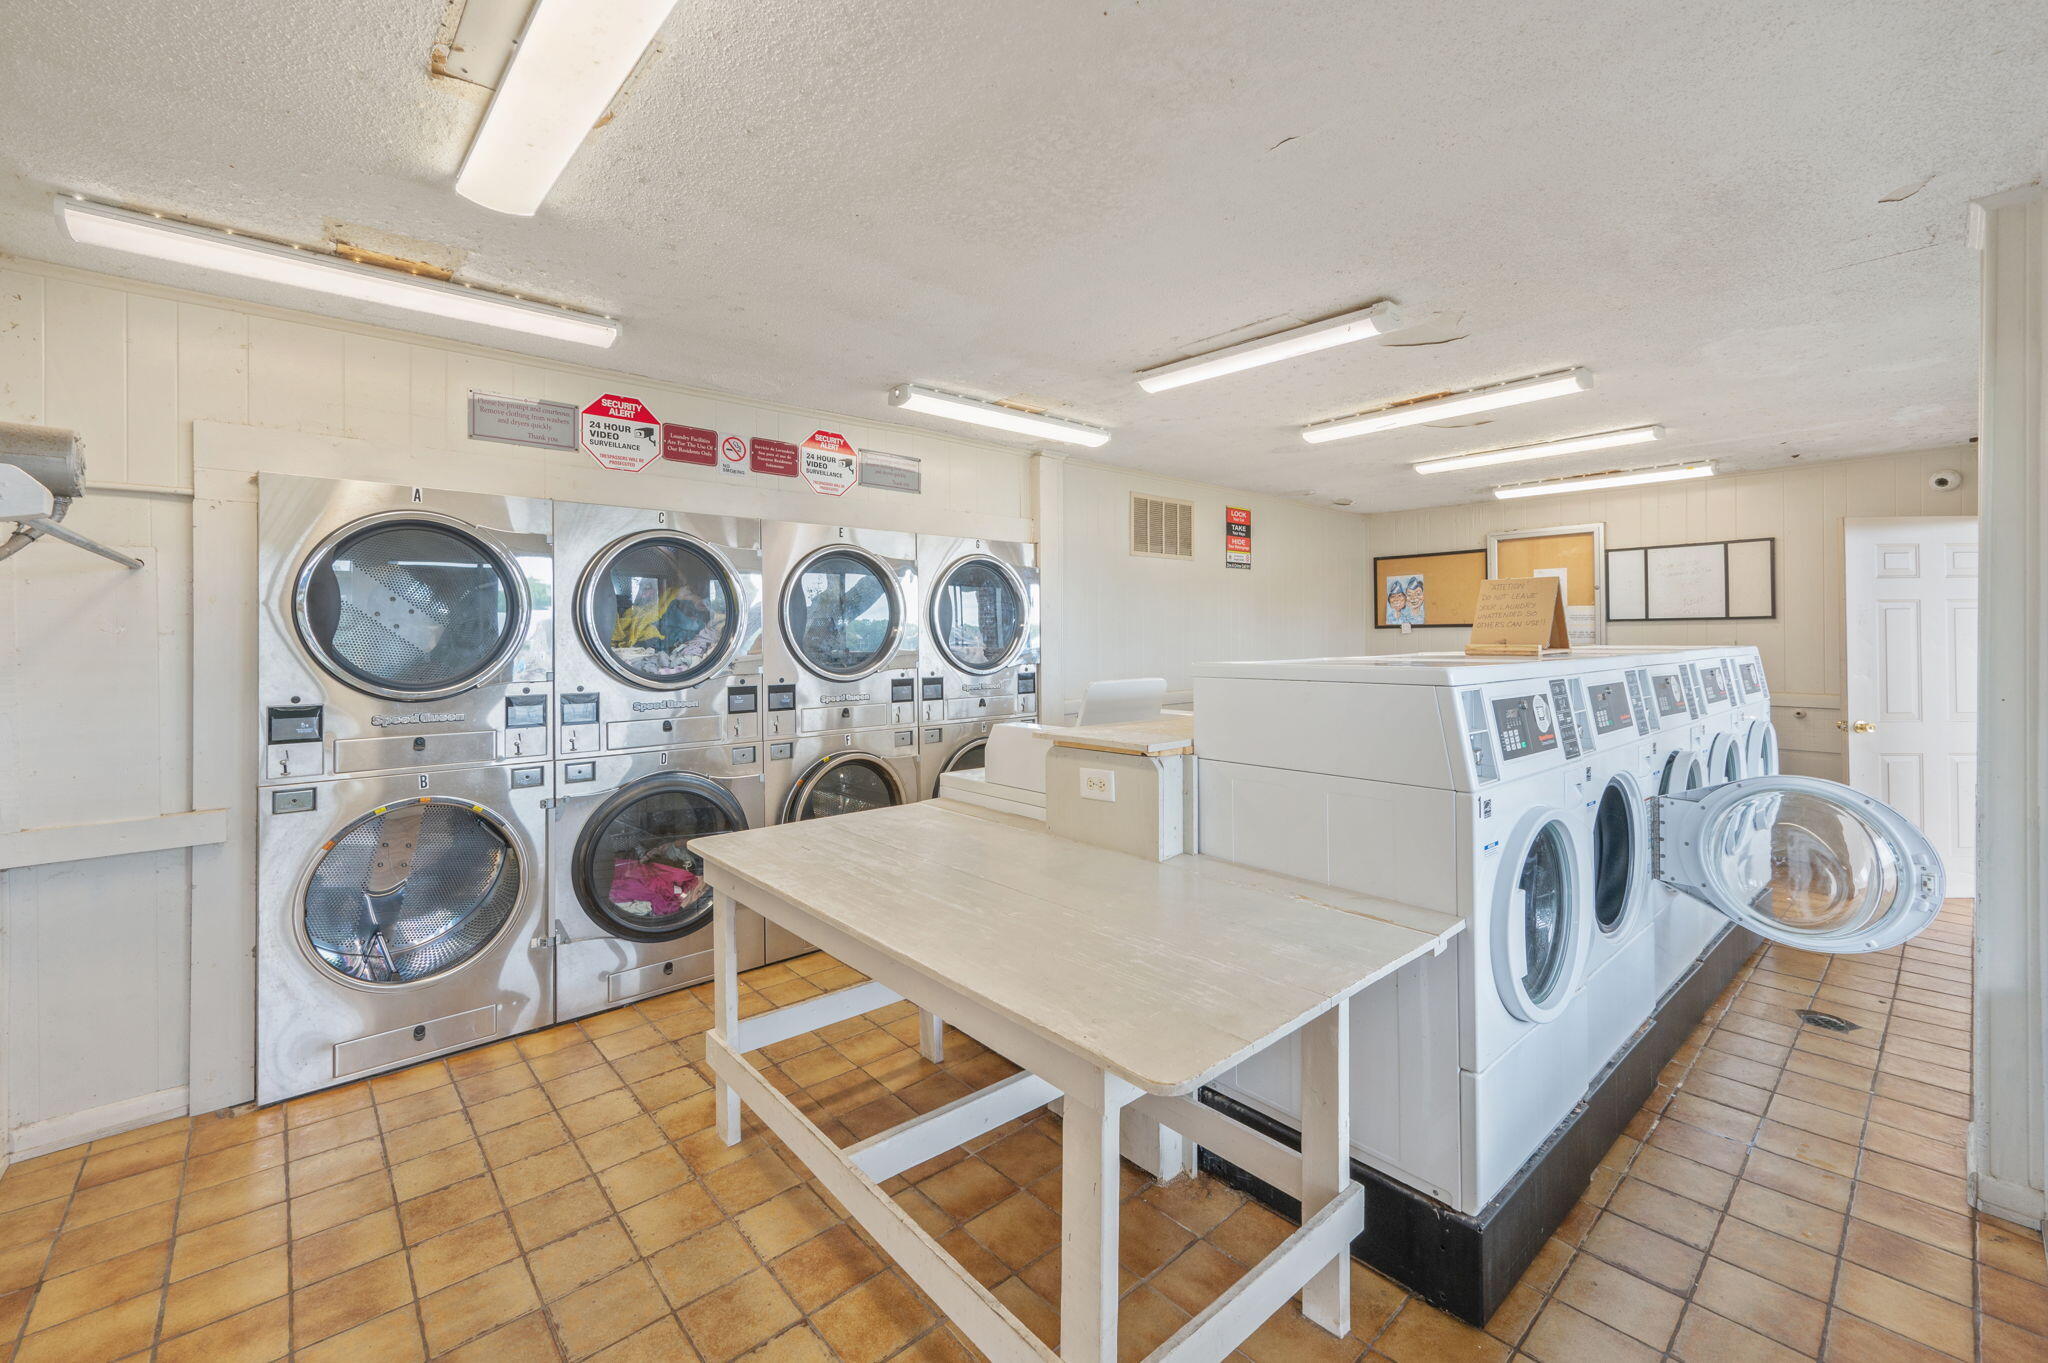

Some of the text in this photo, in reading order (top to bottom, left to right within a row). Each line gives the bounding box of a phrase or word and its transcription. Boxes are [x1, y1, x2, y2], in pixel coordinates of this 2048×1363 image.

[506, 400, 528, 412] prompt
[530, 404, 542, 412] and
[601, 398, 642, 412] SECURITY
[480, 406, 570, 424] Remove clothing from washers
[609, 408, 635, 418] ALERT
[510, 418, 530, 428] dryers
[590, 420, 631, 433] 24 HOUR
[590, 430, 619, 440] VIDEO
[670, 433, 710, 444] Laundry Facilities
[815, 434, 844, 445] SECURITY
[590, 439, 640, 451] SURVEILLANCE
[820, 442, 839, 451] ALERT
[678, 447, 700, 455] Residents
[807, 460, 828, 469] VIDEO
[817, 455, 836, 463] HOUR
[806, 468, 842, 478] SURVEILLANCE
[414, 488, 421, 502] A
[658, 512, 664, 523] C
[839, 527, 844, 537] E
[846, 735, 850, 745] F
[661, 753, 666, 764] D
[420, 775, 427, 788] B
